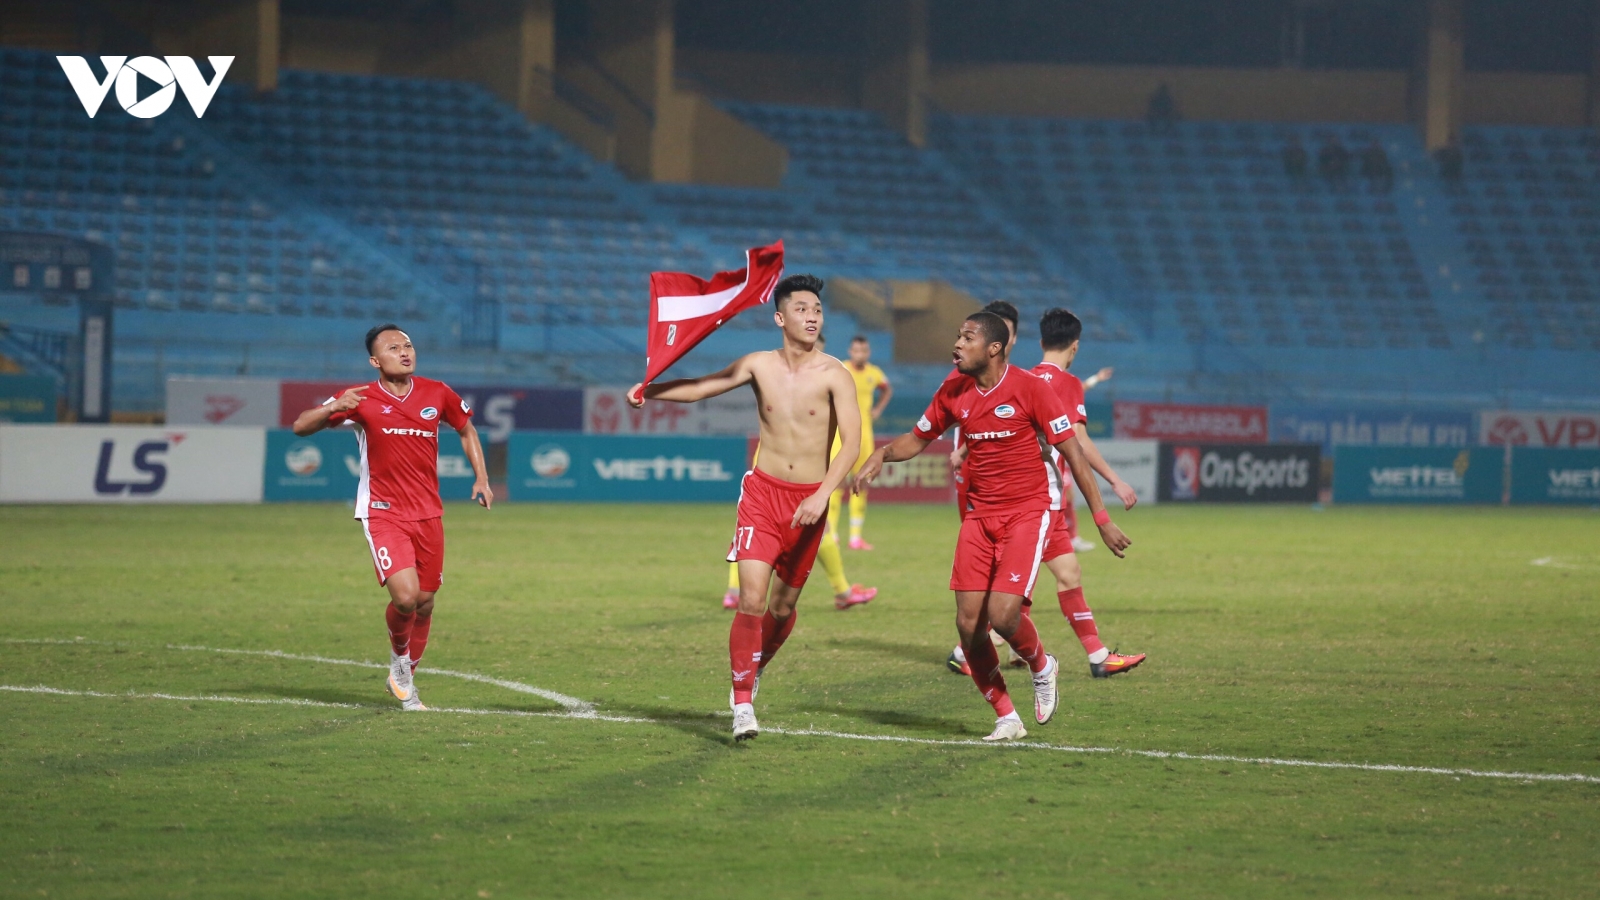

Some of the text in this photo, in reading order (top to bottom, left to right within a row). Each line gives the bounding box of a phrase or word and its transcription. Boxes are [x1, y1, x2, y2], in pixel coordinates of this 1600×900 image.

[1054, 418, 1069, 433] LS
[1536, 416, 1600, 448] VP
[94, 438, 170, 496] LS
[594, 455, 733, 481] VIETTEL
[1200, 450, 1310, 496] OnSports
[377, 546, 393, 571] 8
